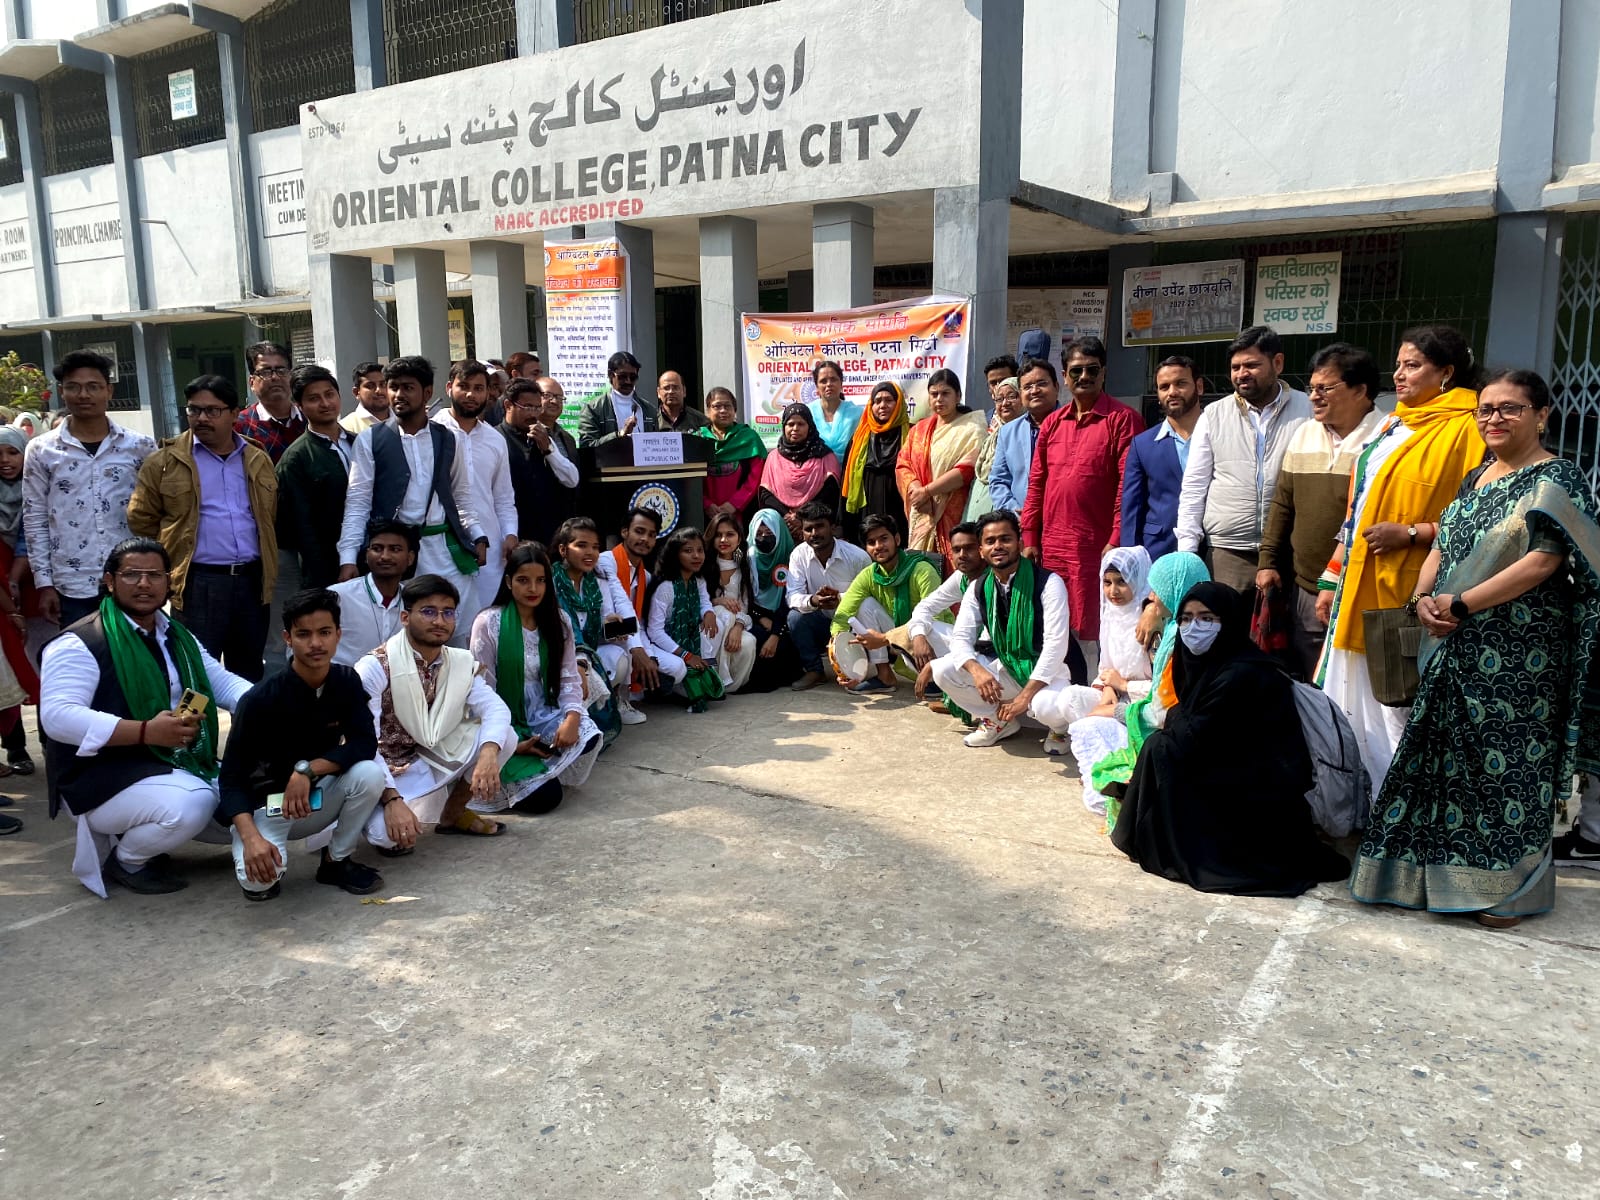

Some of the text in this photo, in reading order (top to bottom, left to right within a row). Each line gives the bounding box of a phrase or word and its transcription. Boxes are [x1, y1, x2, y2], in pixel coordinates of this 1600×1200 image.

[528, 72, 625, 148] کالج
[460, 103, 519, 155] پٹنہ
[332, 176, 480, 229] ORIENTAL
[659, 129, 787, 187] PATNA
[799, 107, 923, 168] CITY
[267, 178, 305, 205] MEETIN
[278, 208, 306, 225] CUM DE
[494, 198, 644, 231] NAAC ACCREDITED
[4, 226, 25, 246] ROOM
[54, 218, 122, 248] PRINCIPAL CHAMBE
[0, 249, 27, 264] ARTMENTS
[1258, 257, 1339, 280] महाविद्यालय
[1264, 280, 1308, 301] परिसर
[1310, 278, 1330, 298] को
[1263, 300, 1329, 322] स्वच्छ रखें
[1305, 322, 1334, 332] NSS
[869, 341, 902, 354] पटना
[908, 334, 938, 353] सिटी
[757, 361, 812, 374] ORIENTAL
[874, 357, 911, 372] PATNA
[914, 355, 947, 369] CITY
